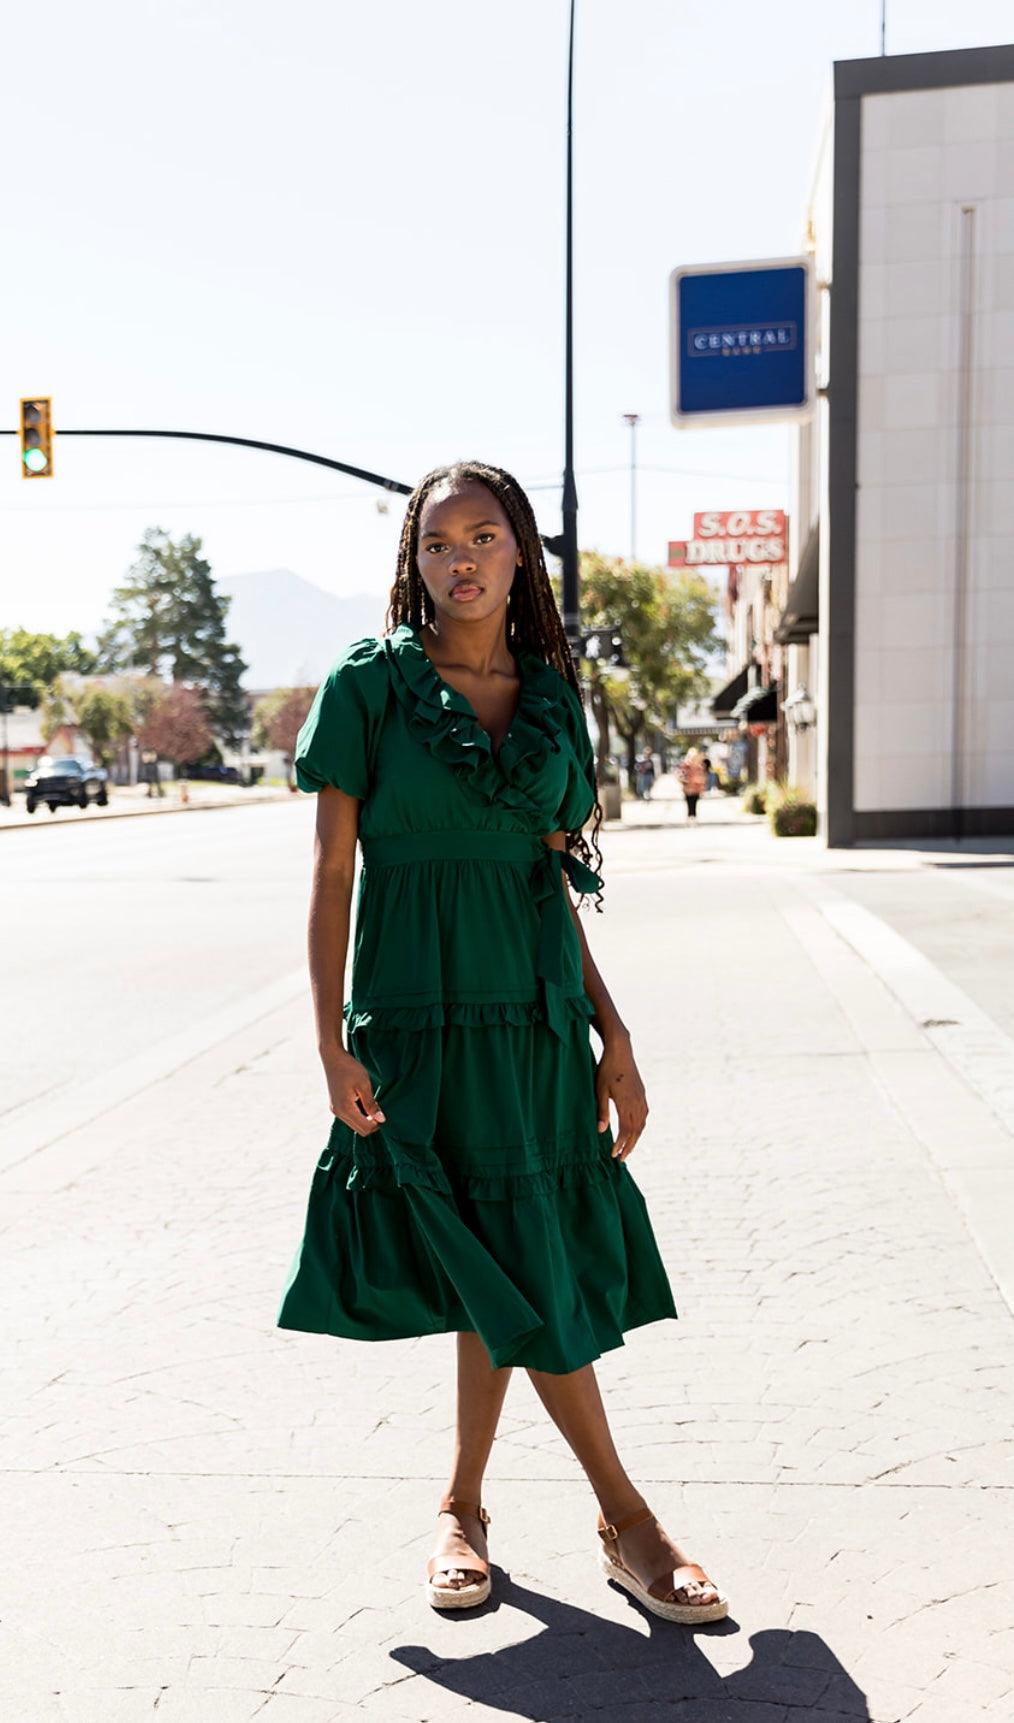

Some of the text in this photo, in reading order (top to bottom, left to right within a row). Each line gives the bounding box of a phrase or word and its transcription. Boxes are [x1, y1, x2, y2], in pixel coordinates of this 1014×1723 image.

[694, 328, 789, 350] CENTRAL
[698, 511, 782, 537] S.O.S.
[686, 539, 784, 564] DRUGS
